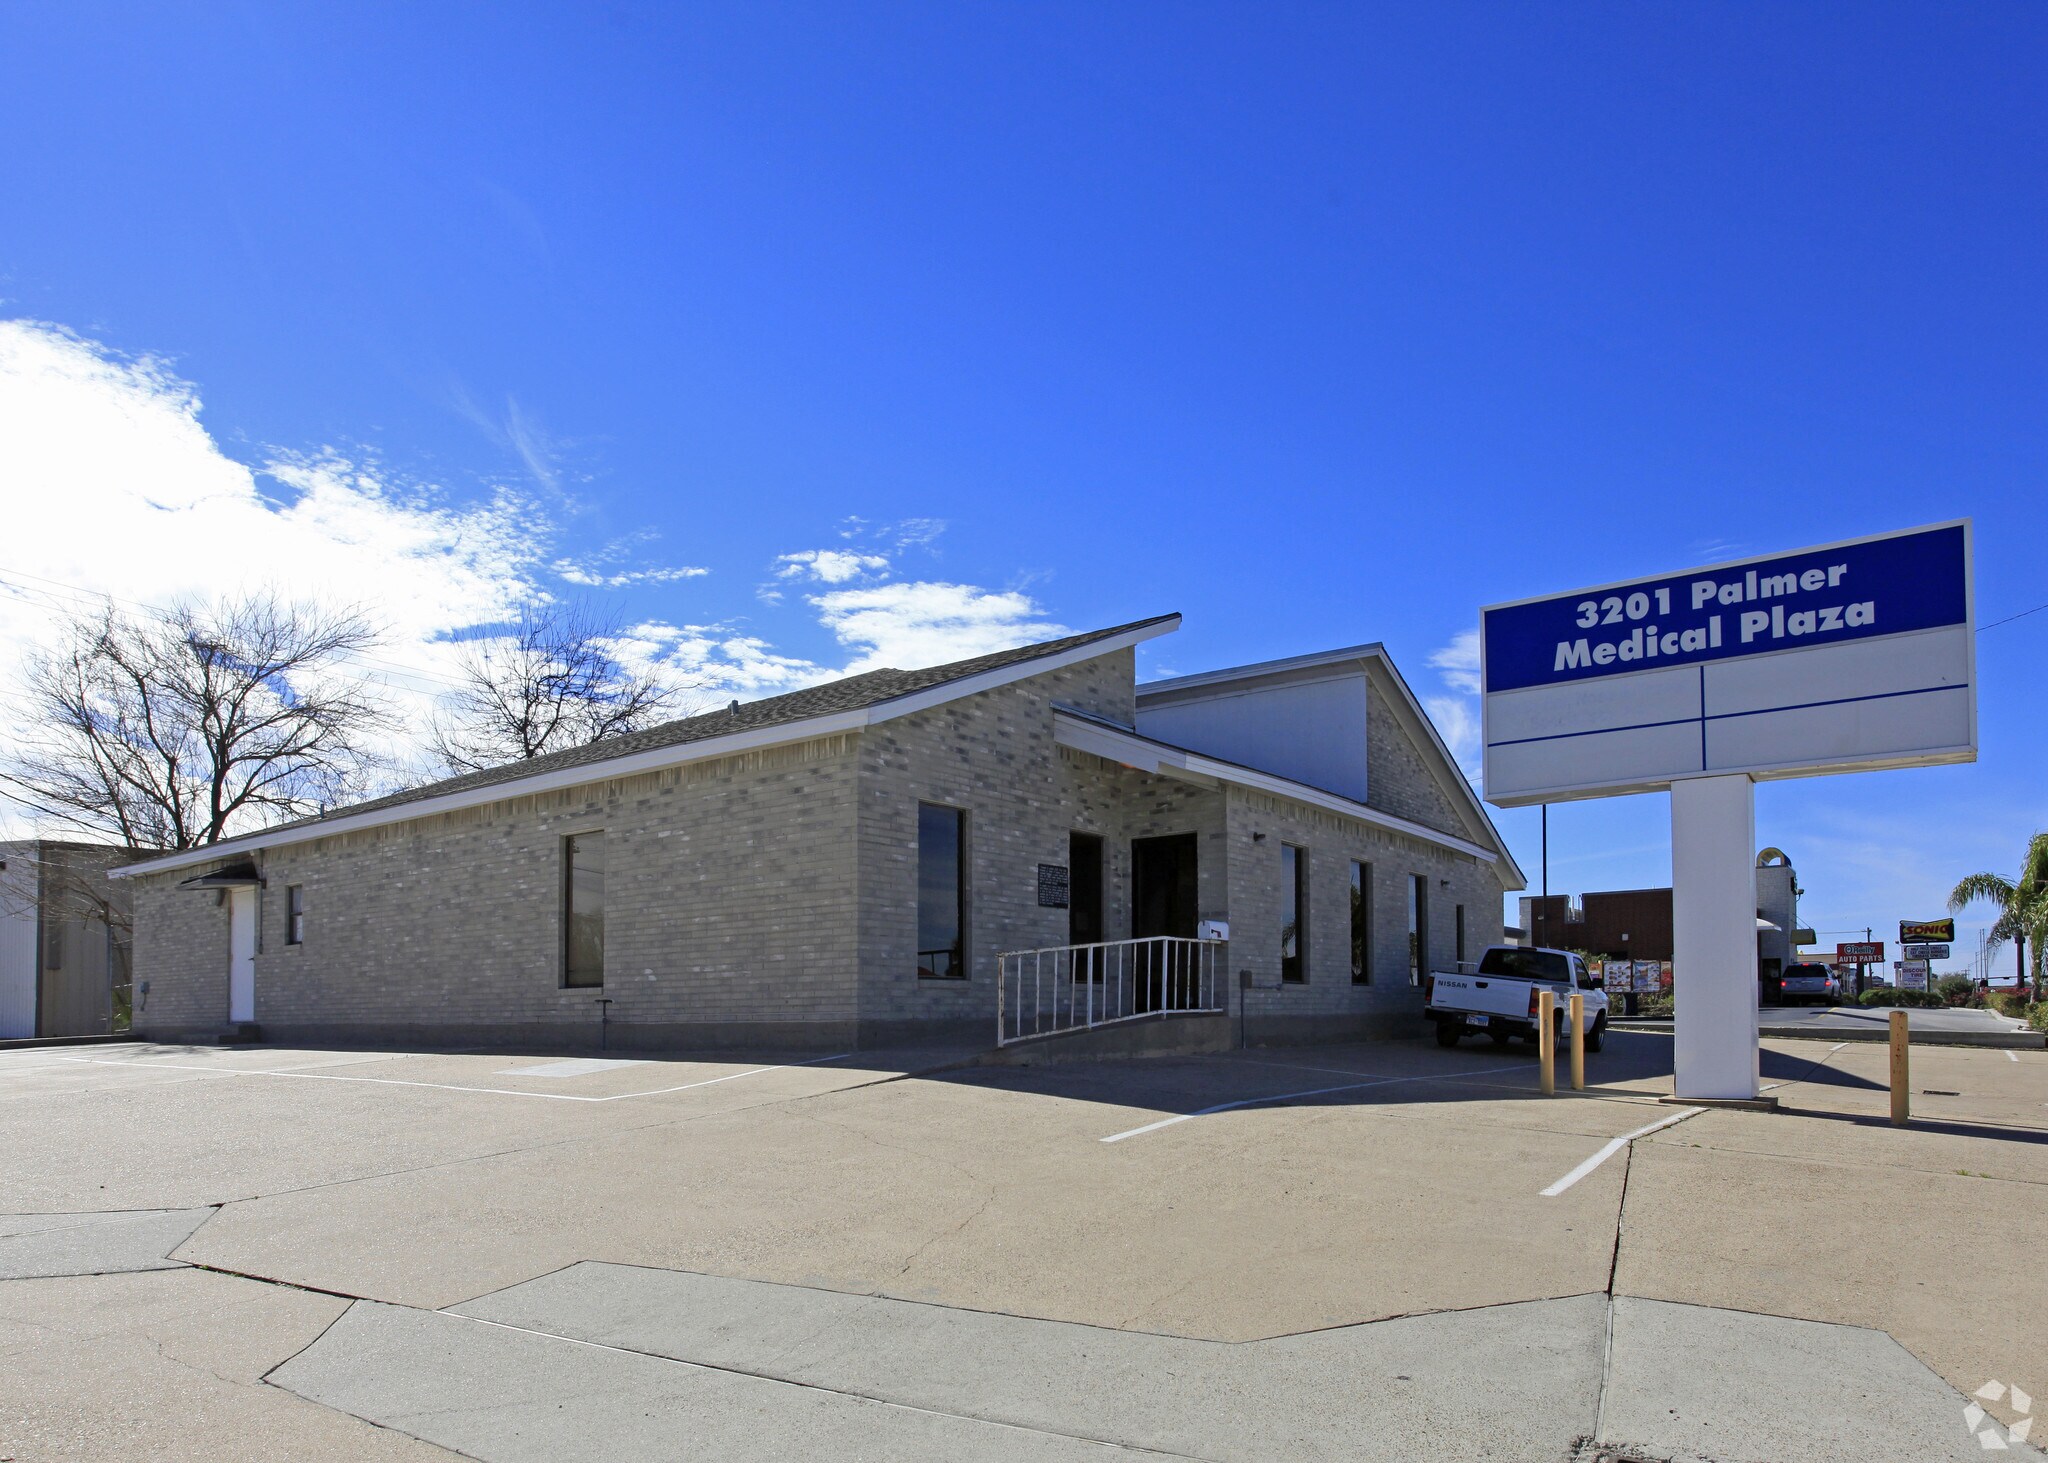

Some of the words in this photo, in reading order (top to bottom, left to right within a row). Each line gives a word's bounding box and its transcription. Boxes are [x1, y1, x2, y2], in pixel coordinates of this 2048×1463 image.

[1576, 587, 1670, 629] 3201
[1691, 563, 1847, 610] Palmer
[1553, 615, 1722, 672] Medical
[1740, 600, 1875, 643] Plaza
[1905, 925, 1949, 935] SONIC
[1844, 944, 1876, 955] O'Reilly
[1437, 980, 1468, 989] NISSAN
